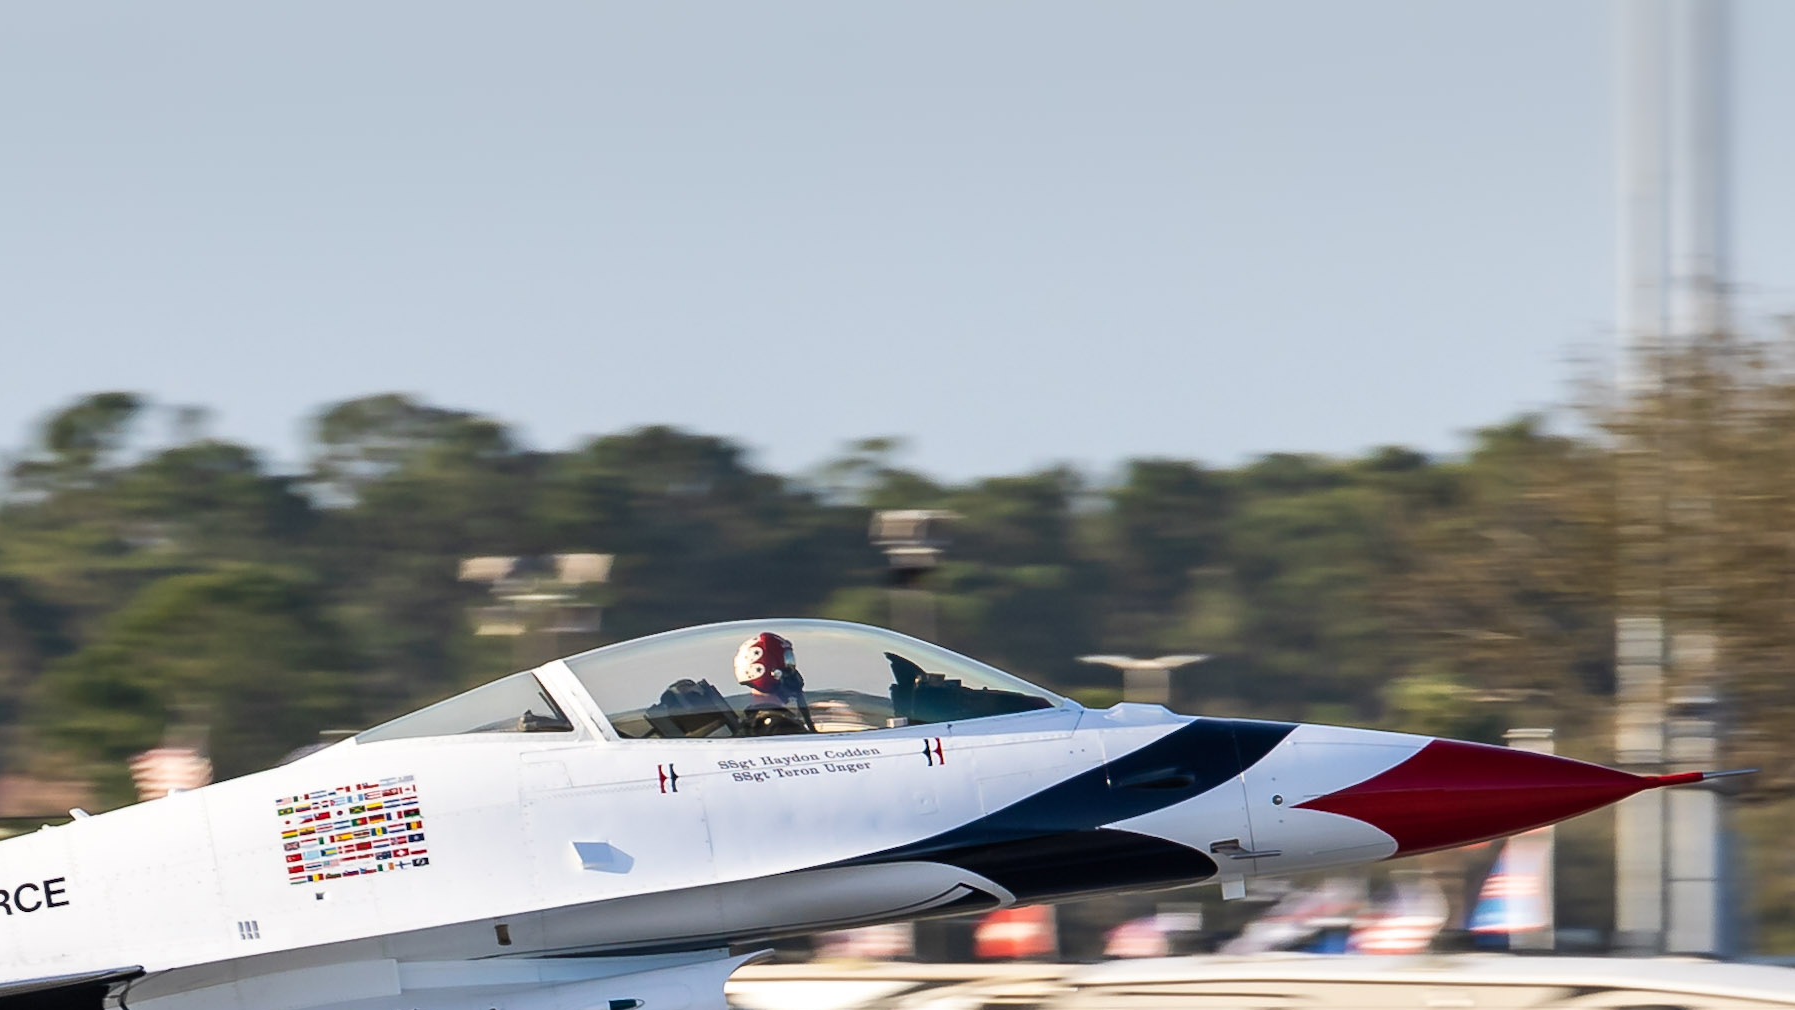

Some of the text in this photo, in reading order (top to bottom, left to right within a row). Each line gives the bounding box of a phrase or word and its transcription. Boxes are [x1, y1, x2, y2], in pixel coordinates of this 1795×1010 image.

[717, 746, 881, 771] SSgt Haydon Codden
[732, 760, 872, 783] SSgt Teron Unger
